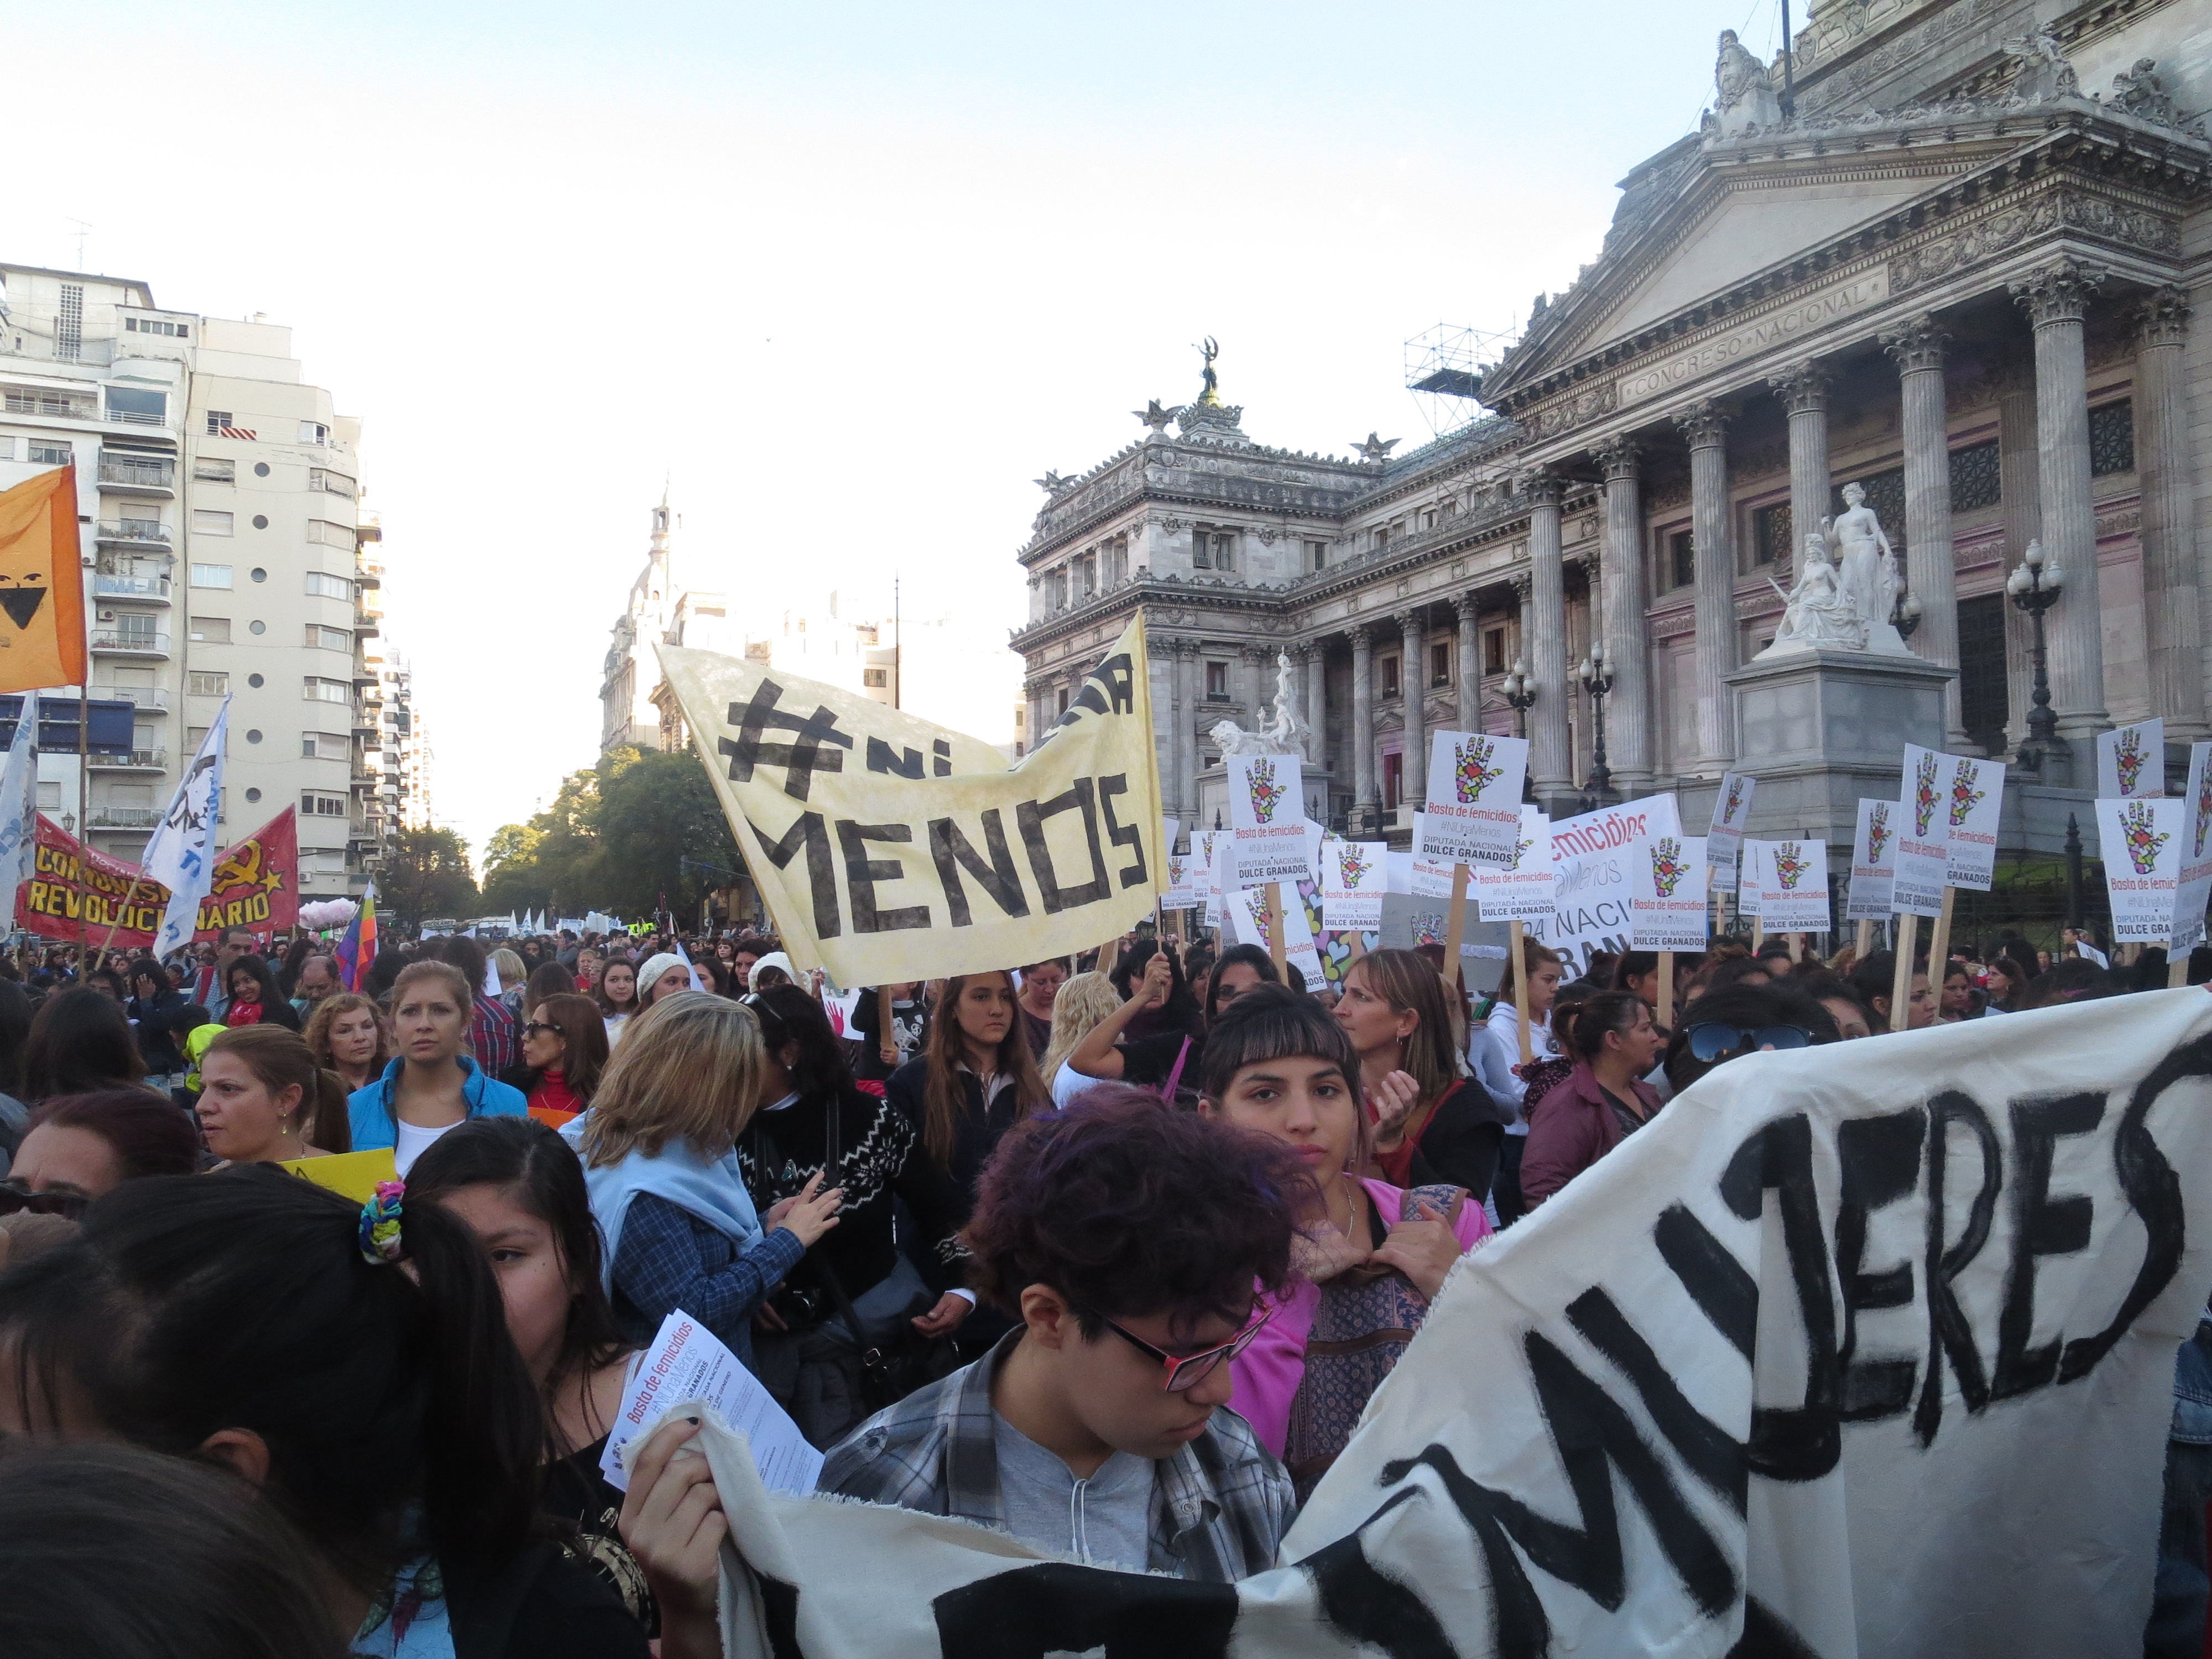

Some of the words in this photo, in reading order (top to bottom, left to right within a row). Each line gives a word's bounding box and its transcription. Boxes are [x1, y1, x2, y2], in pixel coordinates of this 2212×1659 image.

[1635, 337, 1741, 397] CONGRESO
[1755, 284, 1867, 346] NACIONAL
[1428, 802, 1454, 816] Basta
[1456, 806, 1467, 817] de
[1469, 807, 1517, 823] femicidios
[1236, 827, 1256, 839] Basta
[1258, 827, 1266, 837] de
[1268, 824, 1305, 837] femicidios
[1441, 821, 1501, 838] #NiUnaMenos
[1957, 829, 1996, 845] femicidios
[1425, 836, 1466, 847] DIPUTADA
[1469, 841, 1512, 852] NACIONAL
[745, 772, 1149, 940] MENOS
[1423, 844, 1455, 855] DULCE
[1458, 848, 1512, 862] GRANADOS
[1238, 859, 1271, 868] DIPUTADA
[1274, 857, 1307, 865] NACIONAL
[1239, 868, 1264, 878] DULCE
[1266, 864, 1308, 876] GRANADOS
[1480, 874, 1501, 884] Basta
[1503, 874, 1511, 883] de
[1514, 872, 1553, 883] femicidios
[1554, 859, 1622, 898] aMenos
[1947, 870, 1990, 884] GRANADOS
[1210, 885, 1220, 894] Bas
[2111, 878, 2136, 890] Basta
[2137, 878, 2149, 890] de
[1325, 890, 1343, 899] Basta
[1353, 890, 1383, 899] femicidio
[1762, 891, 1781, 900] Basta
[1782, 891, 1791, 899] de
[1792, 890, 1827, 899] femicidios
[1482, 908, 1508, 916] DULCE
[1511, 906, 1556, 915] GRANADOS
[1634, 899, 1655, 910] Basta
[1657, 900, 1666, 910] de
[1667, 900, 1705, 911] femicidios
[2159, 914, 2172, 922] NA
[2117, 925, 2148, 935] DULCE
[2151, 924, 2171, 934] GRA
[1285, 942, 1314, 955] micidios
[1303, 969, 1322, 978] ONAL
[1305, 976, 1324, 987] ADOS
[651, 1322, 693, 1378] femicidios
[685, 1358, 703, 1389] NACIONAL
[709, 1353, 726, 1382] NACIONAL
[644, 1375, 661, 1392] de
[650, 1346, 698, 1414] #NiUnaMenos
[688, 1360, 709, 1399] GRANADOS
[719, 1371, 732, 1395] GENERO
[627, 1390, 653, 1425] Basta
